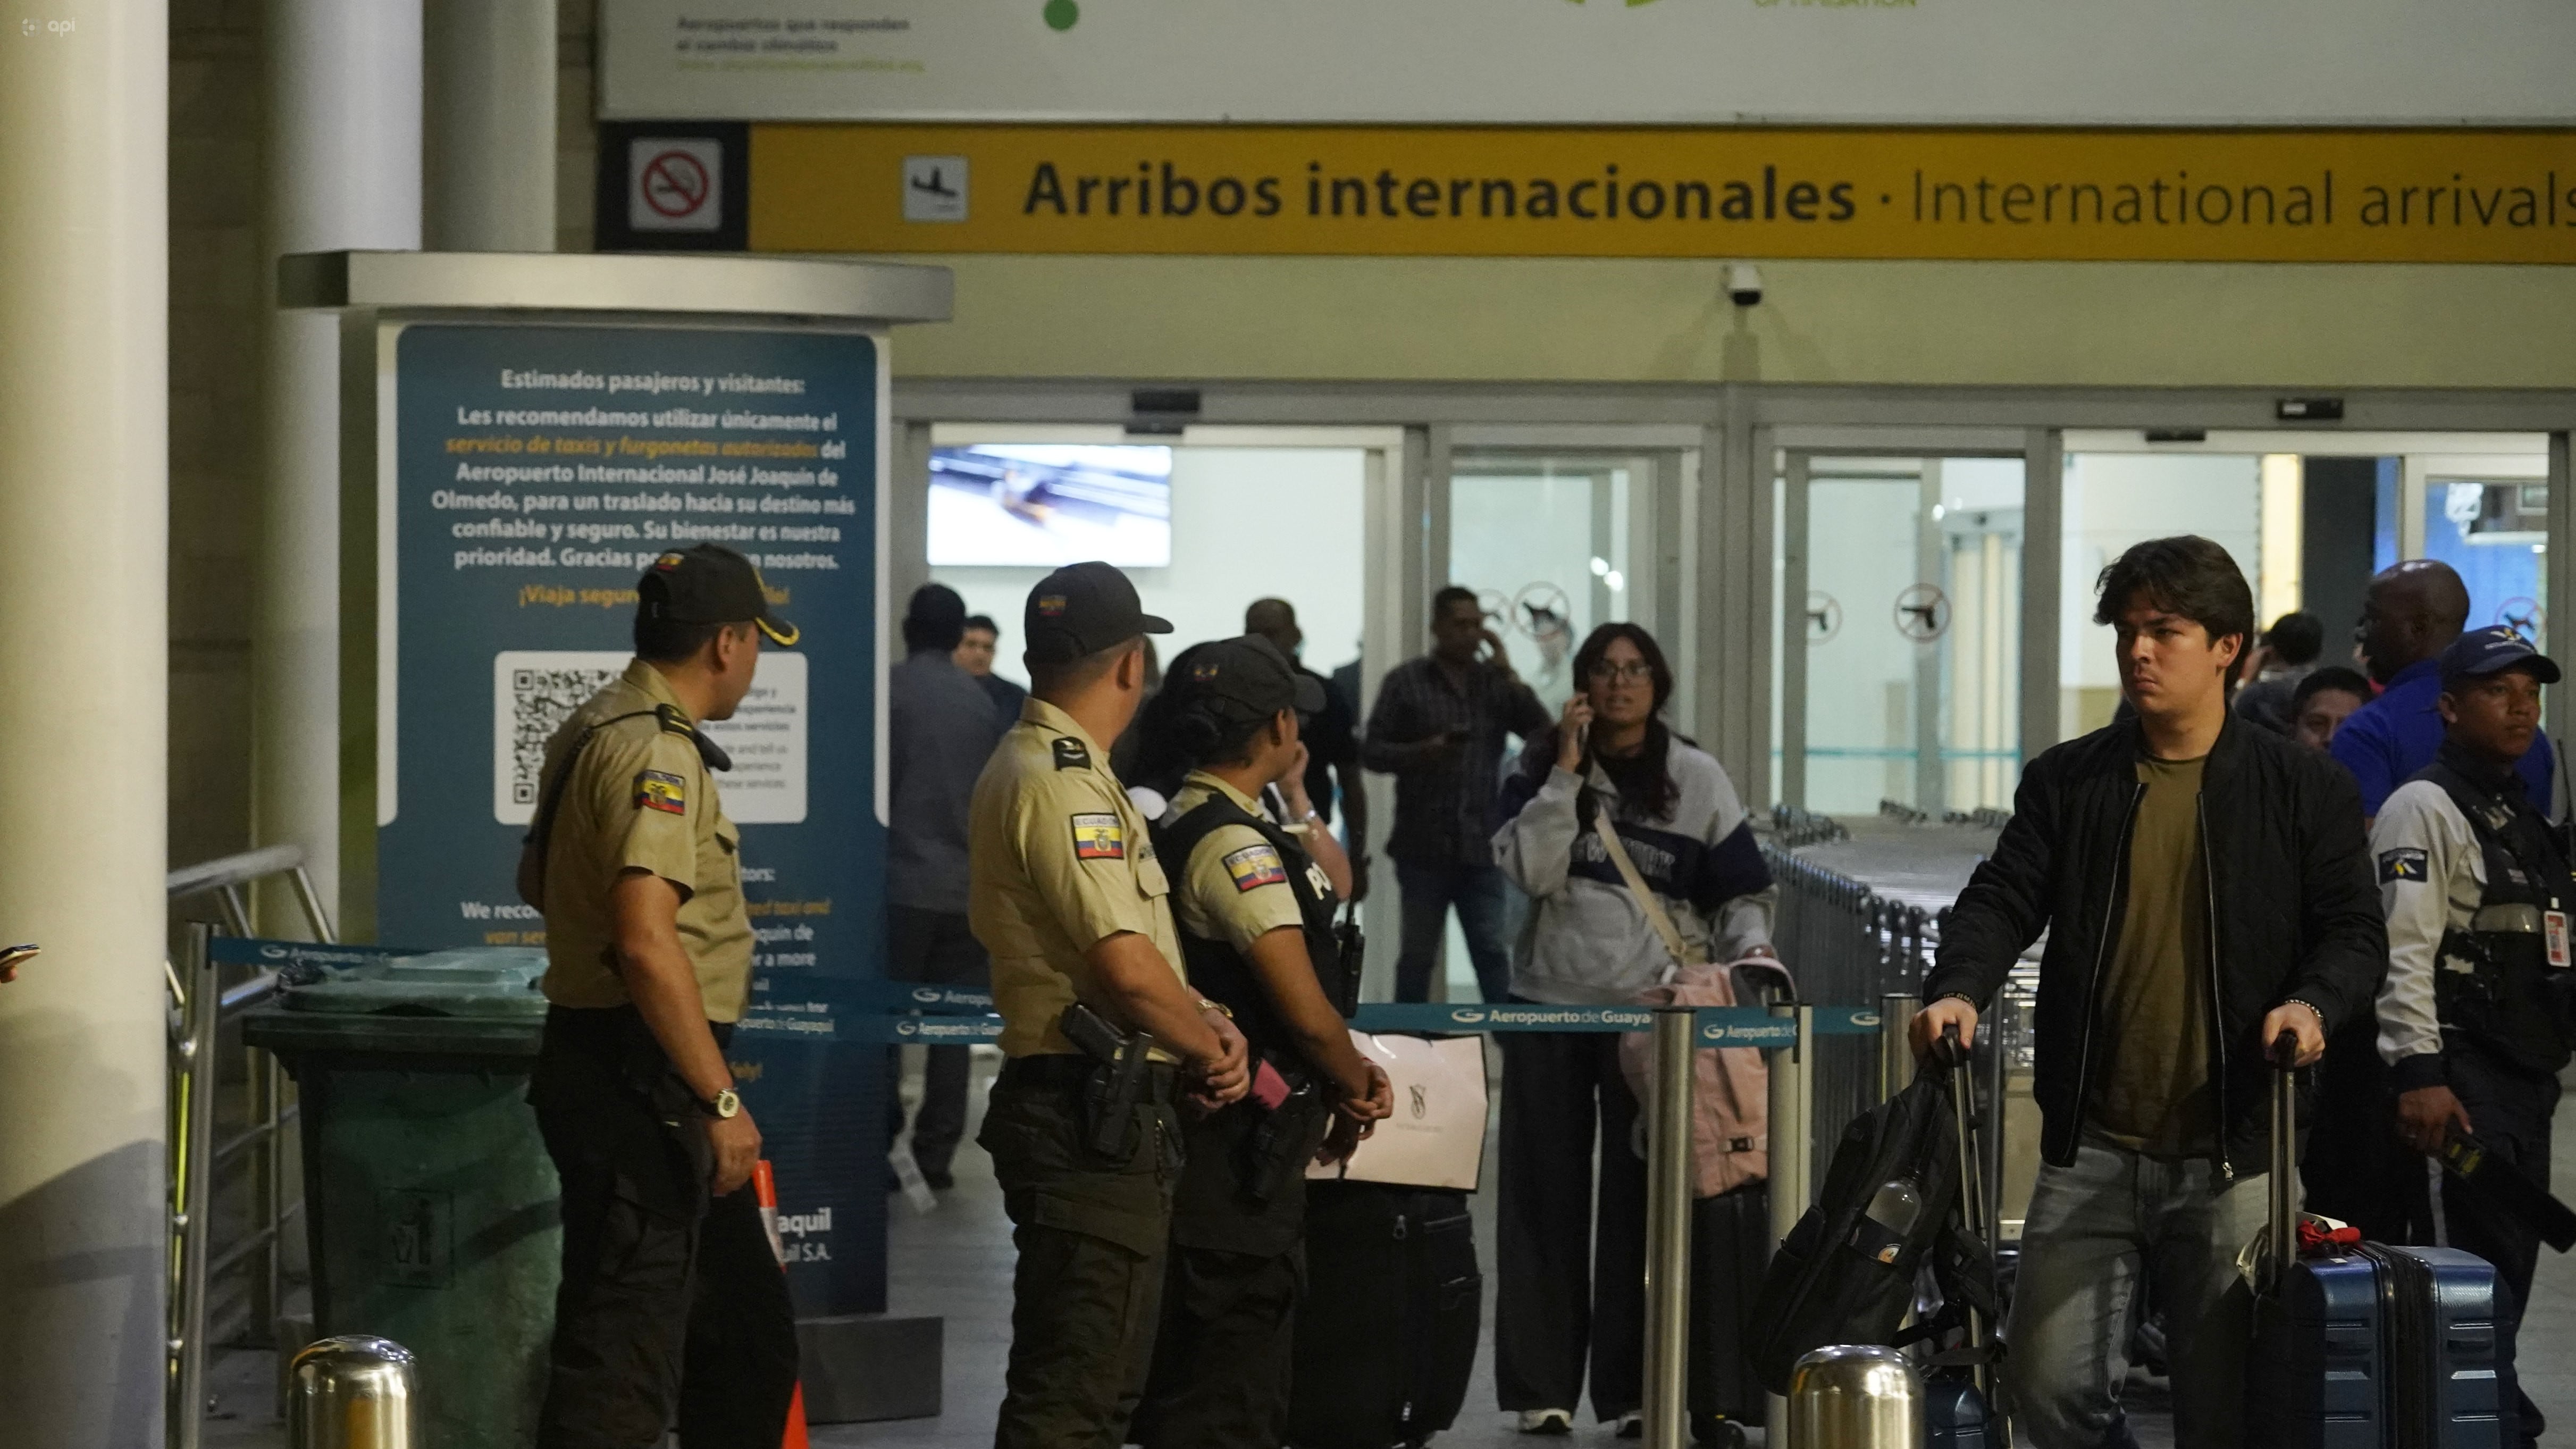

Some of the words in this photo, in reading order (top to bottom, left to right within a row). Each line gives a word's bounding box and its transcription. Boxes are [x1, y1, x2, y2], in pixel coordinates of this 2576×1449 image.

[1022, 160, 1282, 217] Arribos
[1307, 161, 1856, 223] internacionales
[1914, 168, 2332, 227] International
[501, 369, 605, 389] Estimados
[609, 371, 700, 395] pasajeros
[702, 377, 715, 396] y
[457, 406, 492, 425] Les
[496, 406, 649, 427] recomendamos
[652, 408, 718, 429] utilizar
[822, 412, 838, 432] el
[446, 435, 524, 455] servicio
[526, 435, 551, 455] de
[555, 438, 600, 455] taxis
[604, 442, 619, 458] y
[820, 440, 846, 459] del
[456, 462, 574, 486] Aeropuerto
[578, 464, 705, 484] Internacional
[708, 465, 747, 485] José
[818, 467, 839, 488] de
[432, 490, 519, 511] Olmedo,
[523, 493, 569, 514] para
[574, 496, 600, 511] un
[603, 492, 683, 512] traslado
[685, 493, 733, 513] hacia
[736, 498, 757, 513] su
[759, 494, 822, 514] destino
[451, 517, 548, 538] confiable
[550, 523, 564, 543] y
[567, 523, 640, 543] seguro.
[642, 520, 667, 540] Su
[670, 521, 755, 541] bienestar
[758, 526, 778, 541] es
[780, 526, 842, 543] nuestra
[454, 546, 558, 570] prioridad.
[560, 547, 632, 567] Gracias
[636, 552, 660, 572] po
[763, 552, 840, 570] nosotros.
[741, 867, 776, 882] tors:
[1305, 861, 1332, 900] PO
[460, 900, 491, 919] We
[1489, 1009, 1580, 1026] Aeropuerto
[1600, 1009, 1652, 1027] Guaya
[776, 1206, 832, 1238] aquil
